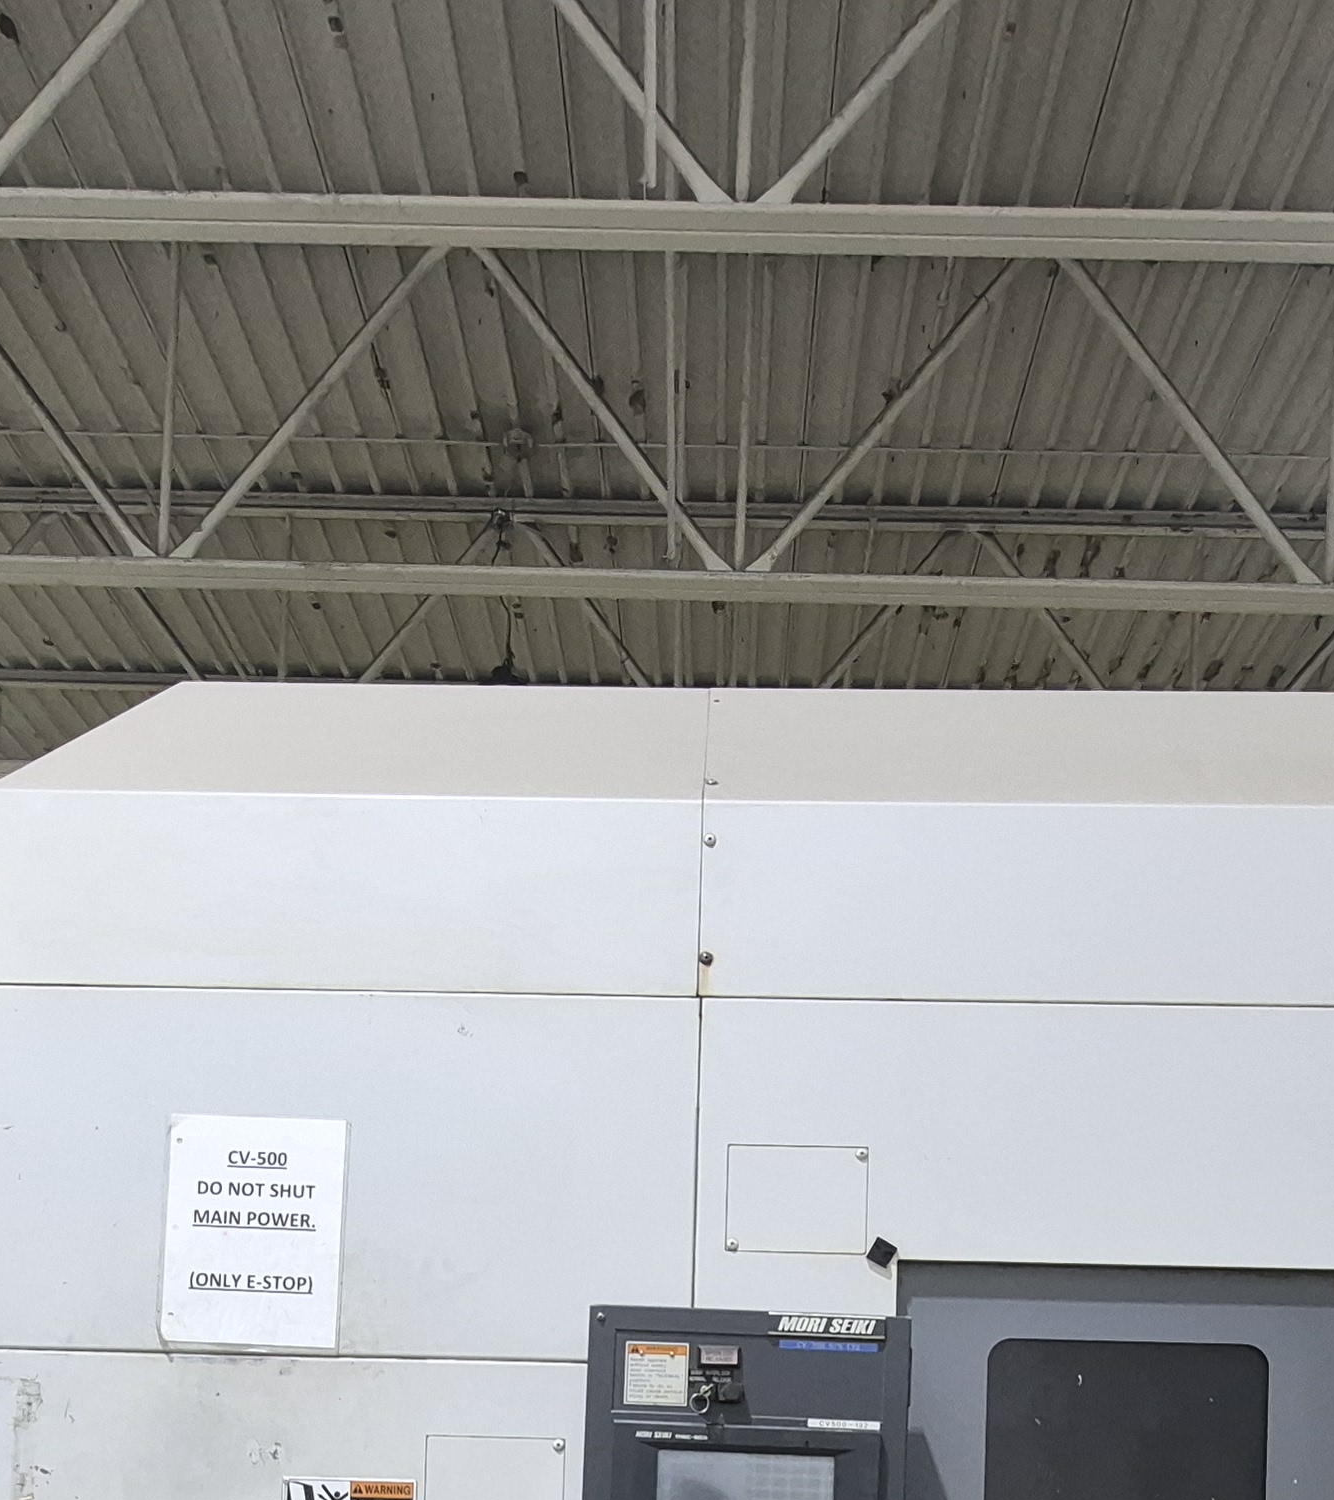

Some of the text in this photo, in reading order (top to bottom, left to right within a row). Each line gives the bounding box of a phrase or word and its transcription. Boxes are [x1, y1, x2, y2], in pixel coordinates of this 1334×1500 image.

[227, 1150, 288, 1166] CV-500
[197, 1180, 316, 1200] DO NOT SHUT
[193, 1209, 316, 1228] MAIN POWER.
[189, 1271, 313, 1294] (ONLY E-STOP)
[777, 1316, 877, 1335] MORI SEIKI
[364, 1484, 411, 1496] WARNING
